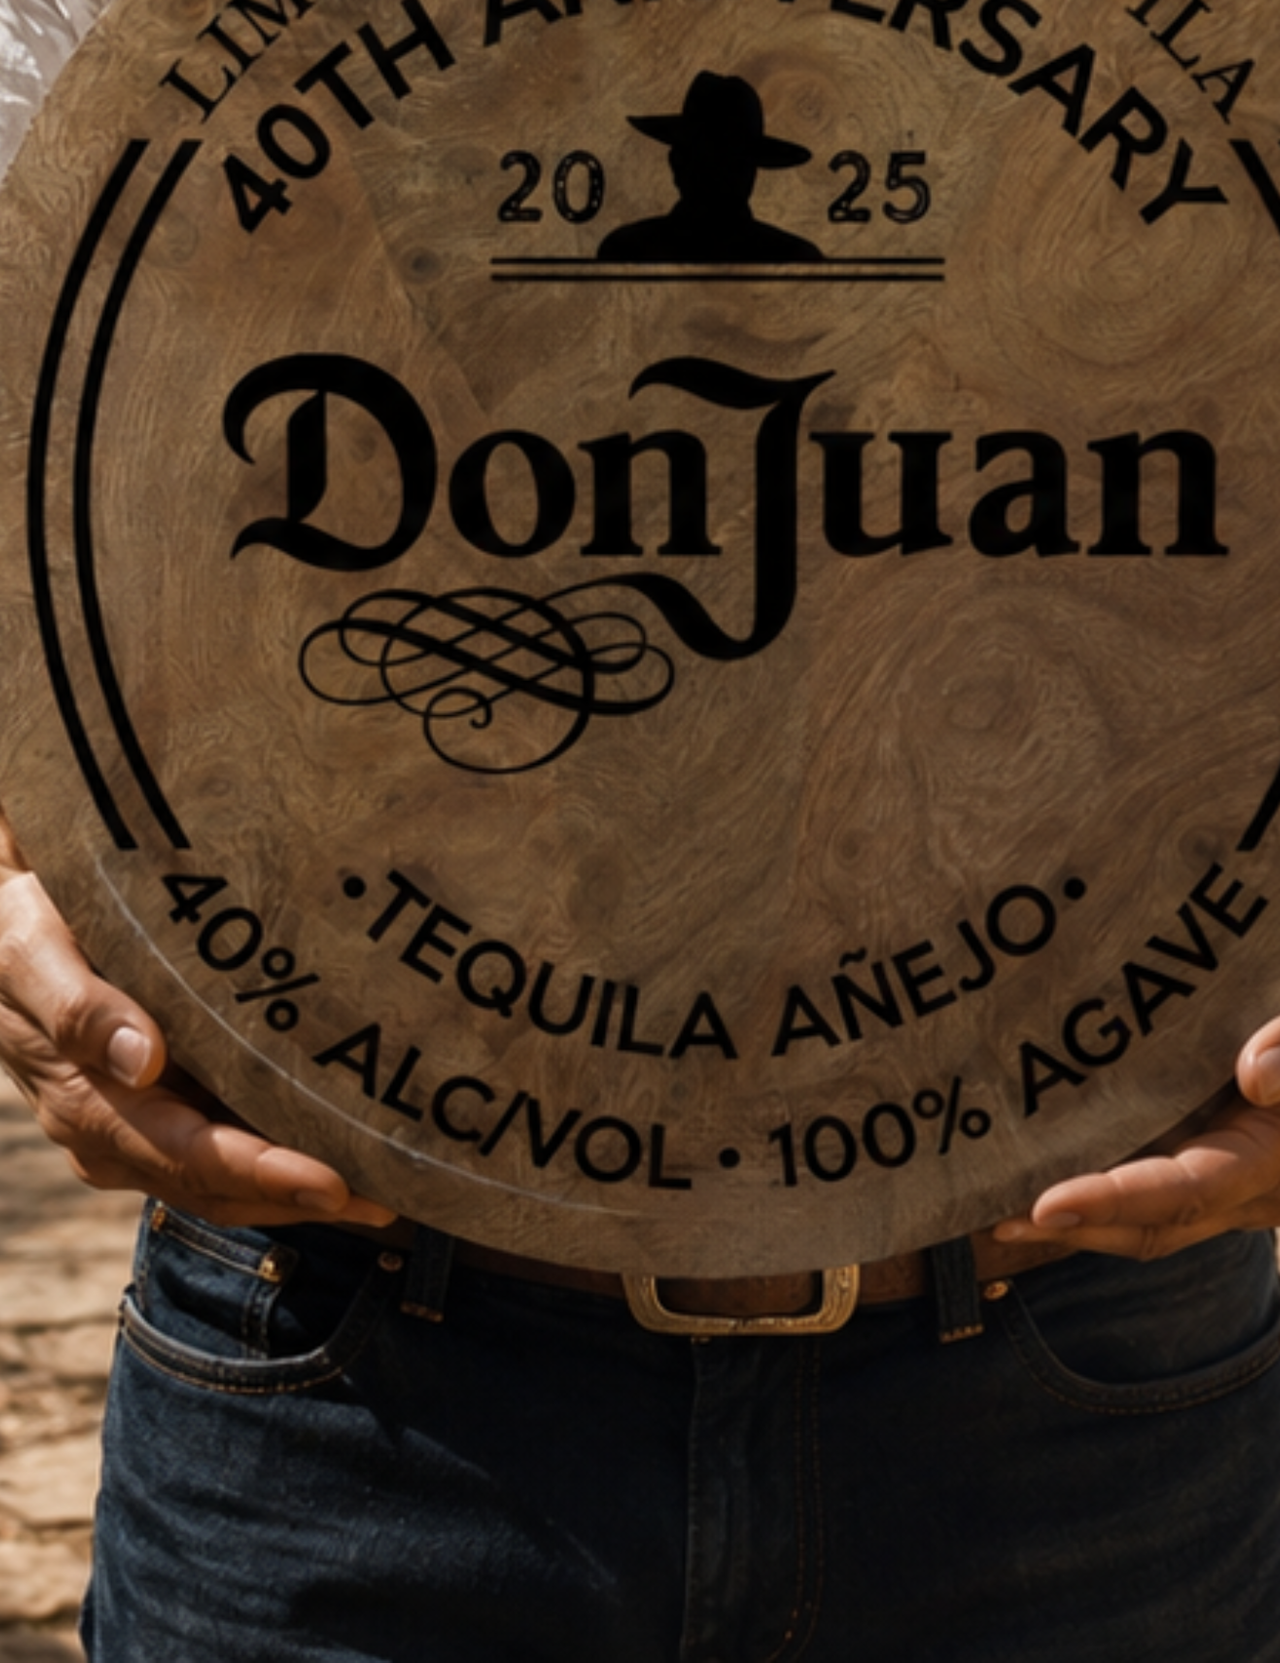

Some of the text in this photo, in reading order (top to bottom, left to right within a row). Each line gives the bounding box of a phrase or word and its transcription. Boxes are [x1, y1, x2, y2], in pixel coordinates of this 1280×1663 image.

[497, 150, 931, 225] 20 25
[161, 872, 300, 1032] 40%
[311, 1022, 692, 1190] ALC/VOL
[768, 1088, 991, 1187] 100%
[1019, 860, 1269, 1118] AGAVE
